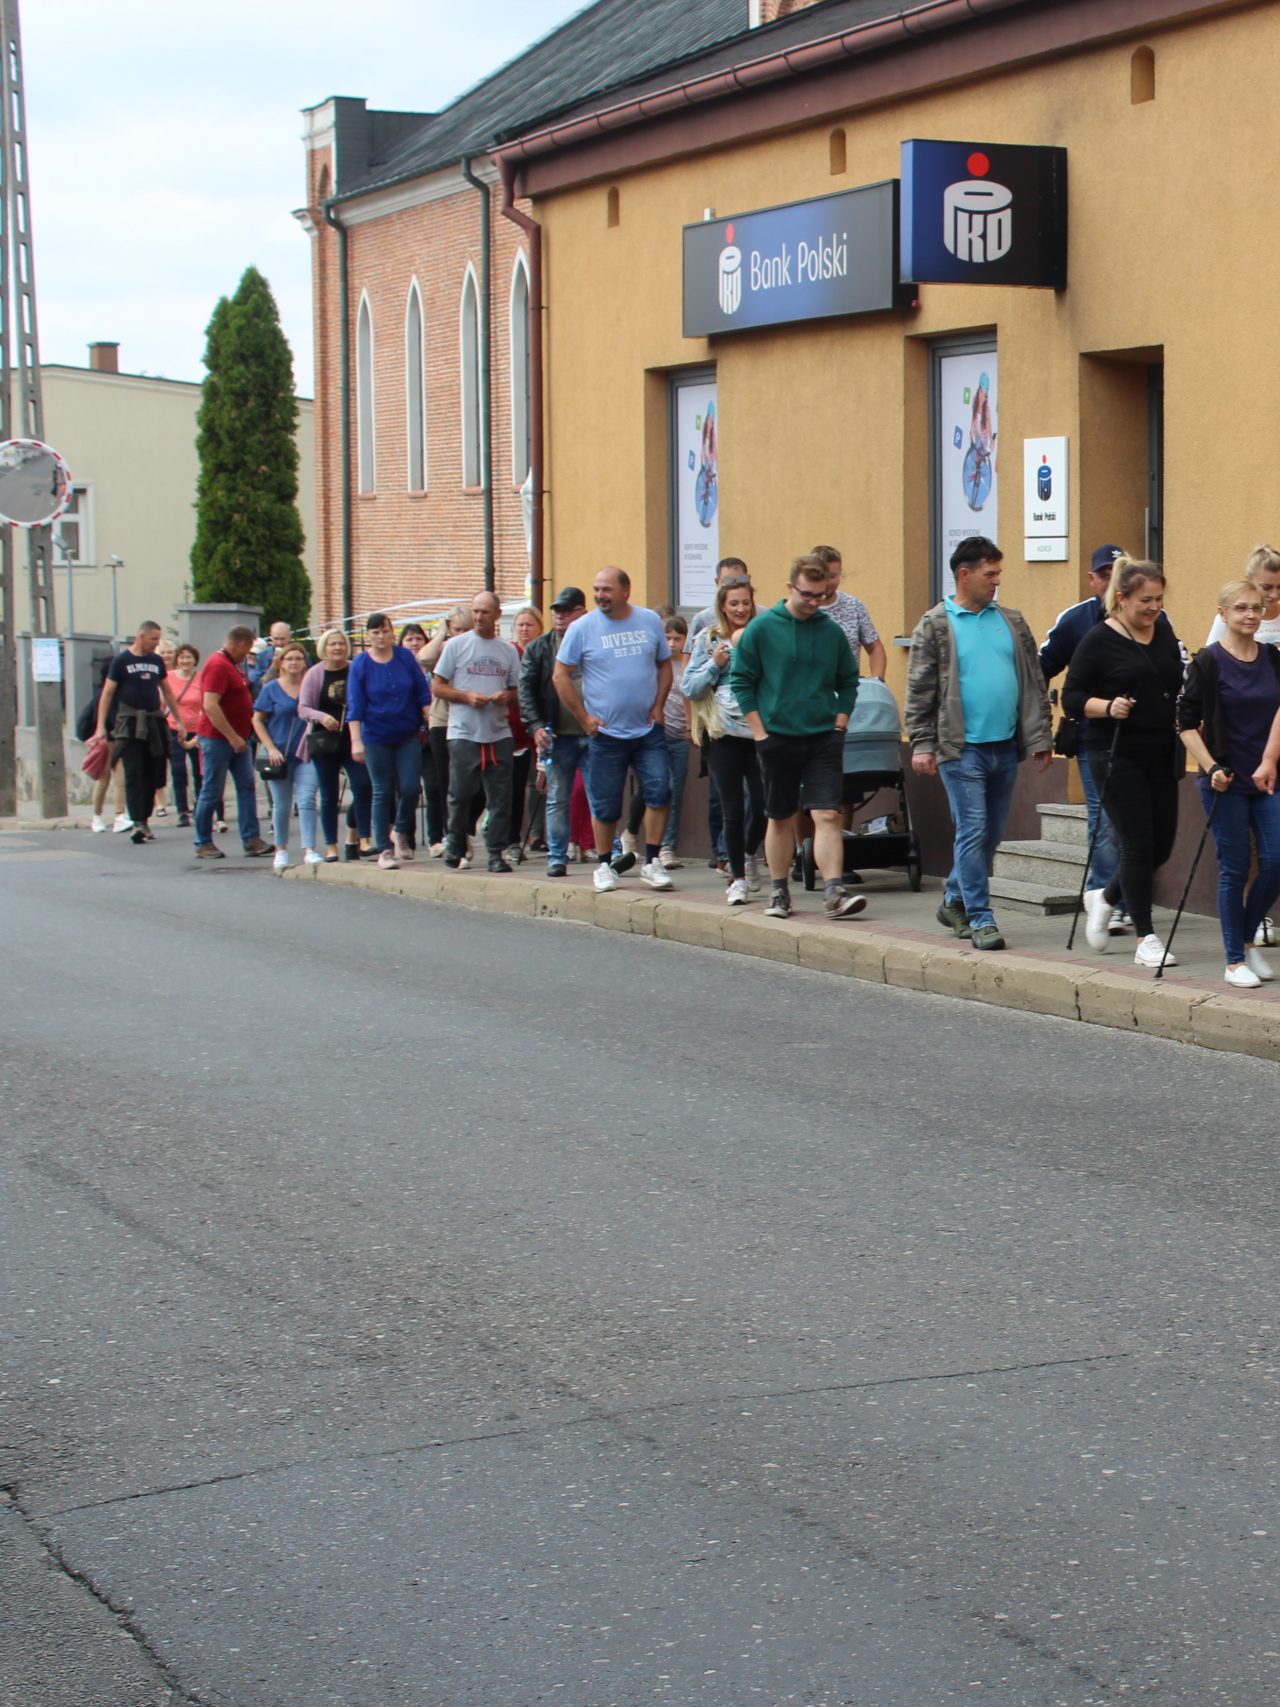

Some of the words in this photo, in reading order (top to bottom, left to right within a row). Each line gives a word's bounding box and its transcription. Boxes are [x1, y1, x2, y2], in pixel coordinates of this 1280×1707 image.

[750, 242, 792, 291] Bank
[797, 232, 848, 284] Polski
[601, 630, 648, 648] DIVERSE
